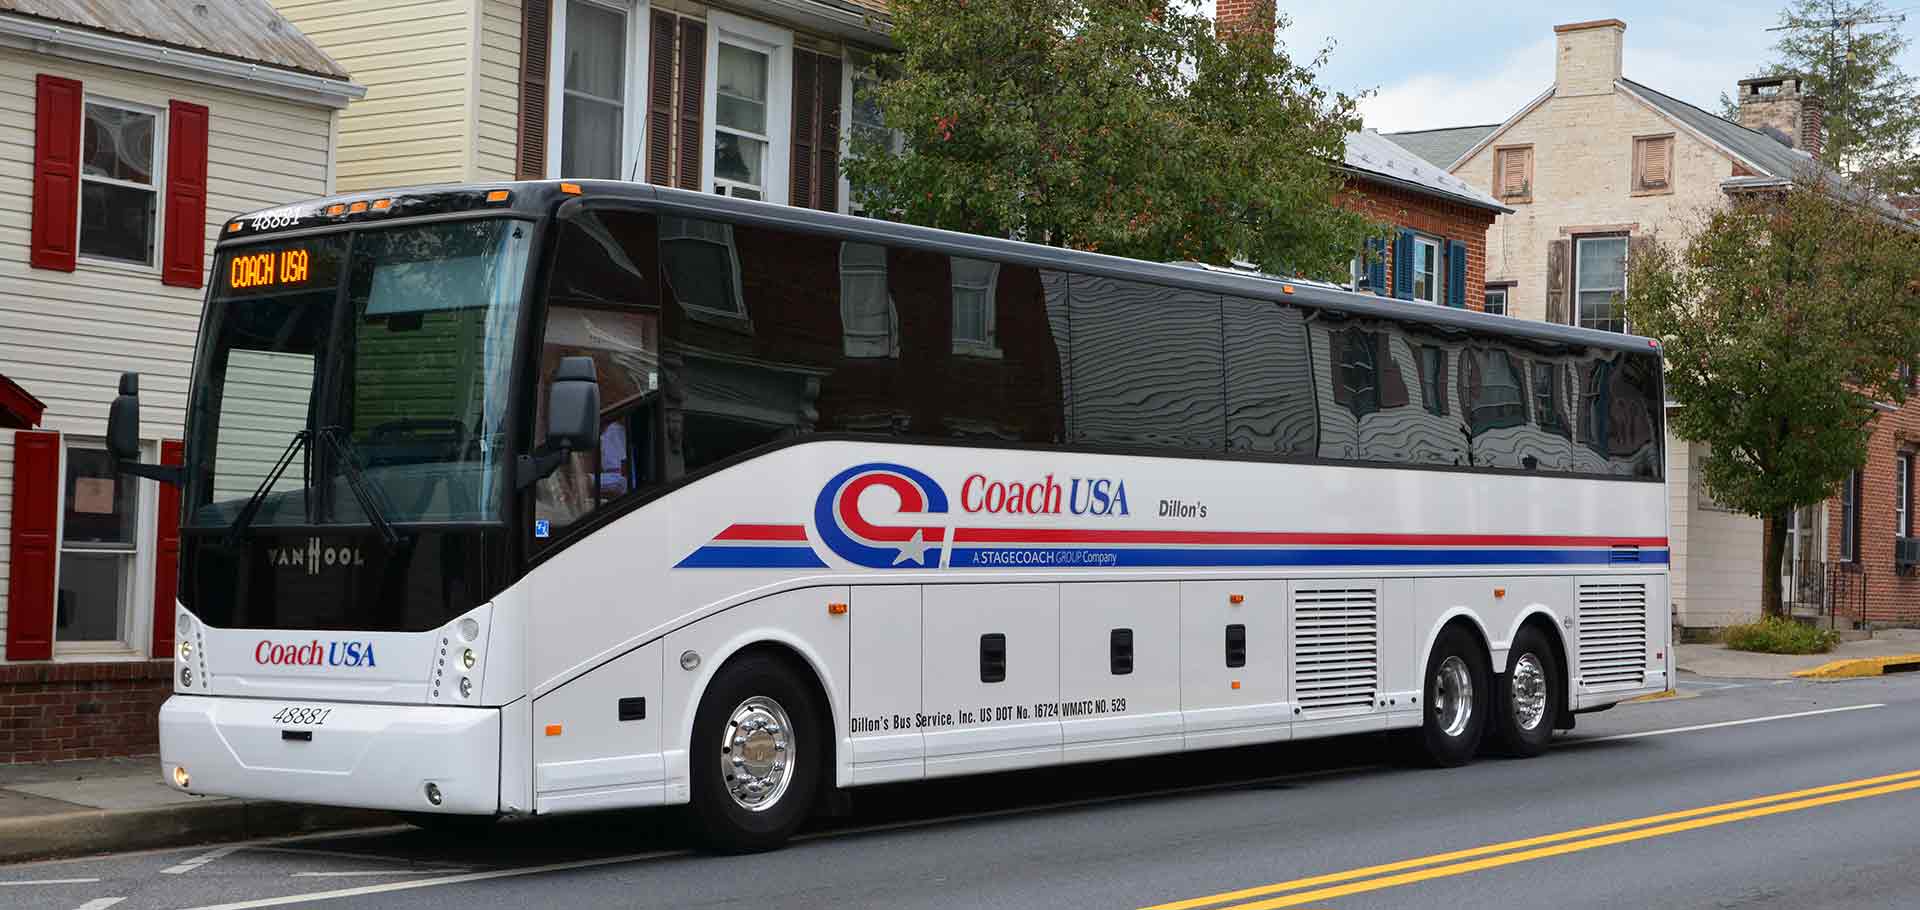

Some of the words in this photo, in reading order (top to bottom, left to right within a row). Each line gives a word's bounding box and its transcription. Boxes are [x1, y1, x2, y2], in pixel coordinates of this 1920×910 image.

[251, 206, 303, 231] 48881
[231, 253, 275, 288] COACH
[280, 249, 308, 283] USA
[960, 474, 1062, 514] Coach
[1069, 478, 1129, 515] USA
[1158, 500, 1208, 518] Dillon's
[973, 551, 980, 564] A
[981, 551, 1055, 564] STAGECOACH
[1056, 551, 1083, 564] GROUP
[1082, 550, 1118, 566] Company
[255, 640, 323, 666] Coach
[328, 641, 376, 667] USA
[272, 707, 332, 725] 48881
[851, 716, 889, 733] Dillon's
[893, 714, 911, 729] Bus
[959, 709, 976, 724] Inc.
[980, 708, 992, 722] US
[996, 706, 1013, 721] DOT
[1017, 705, 1031, 719] No.
[1034, 703, 1059, 718] 16724
[1062, 700, 1093, 716] WMATC
[1095, 699, 1109, 713] NO.
[1111, 698, 1126, 712] 529
